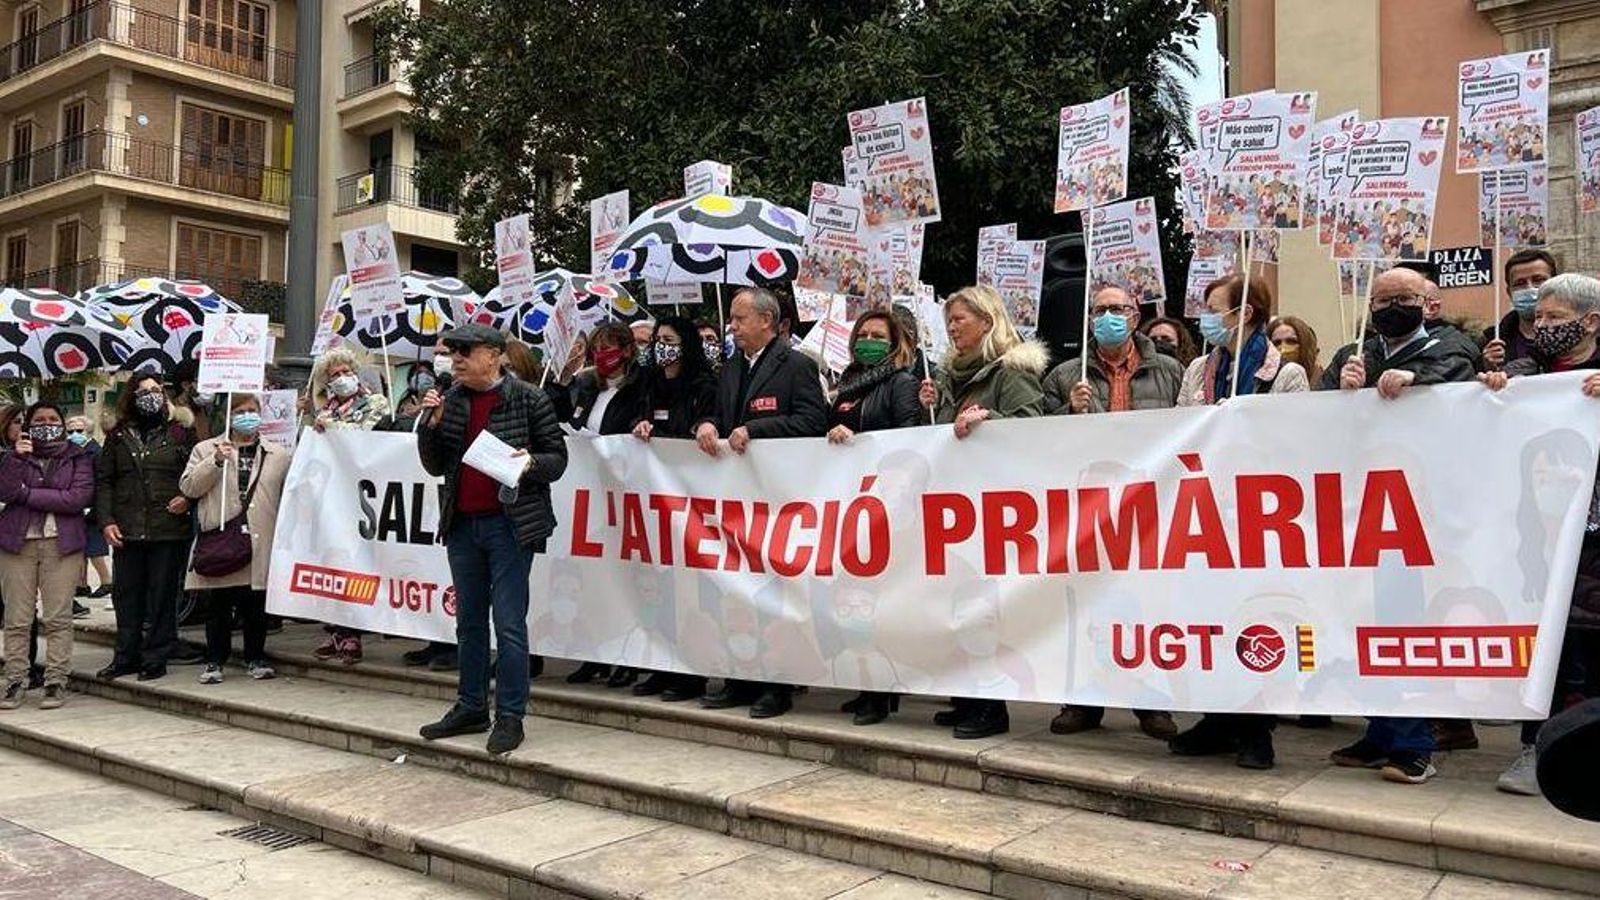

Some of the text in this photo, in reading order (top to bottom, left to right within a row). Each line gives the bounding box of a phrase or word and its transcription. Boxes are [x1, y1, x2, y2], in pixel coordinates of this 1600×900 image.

[1225, 124, 1241, 136] Más
[1243, 122, 1274, 134] centros
[1230, 136, 1265, 148] de salud
[1239, 152, 1281, 164] SALVEMOS
[1264, 159, 1297, 171] PRIMARIA
[1365, 180, 1408, 190] SALVEMOS
[1434, 247, 1482, 264] PLAZA
[1441, 263, 1476, 273] DE LA
[358, 452, 1436, 578] SAL L'ATENCIÓ PRIMÀRIA
[297, 570, 348, 595] CCOO
[389, 578, 439, 613] UGT
[1112, 622, 1224, 671] UGT
[1367, 635, 1512, 668] CCOO
